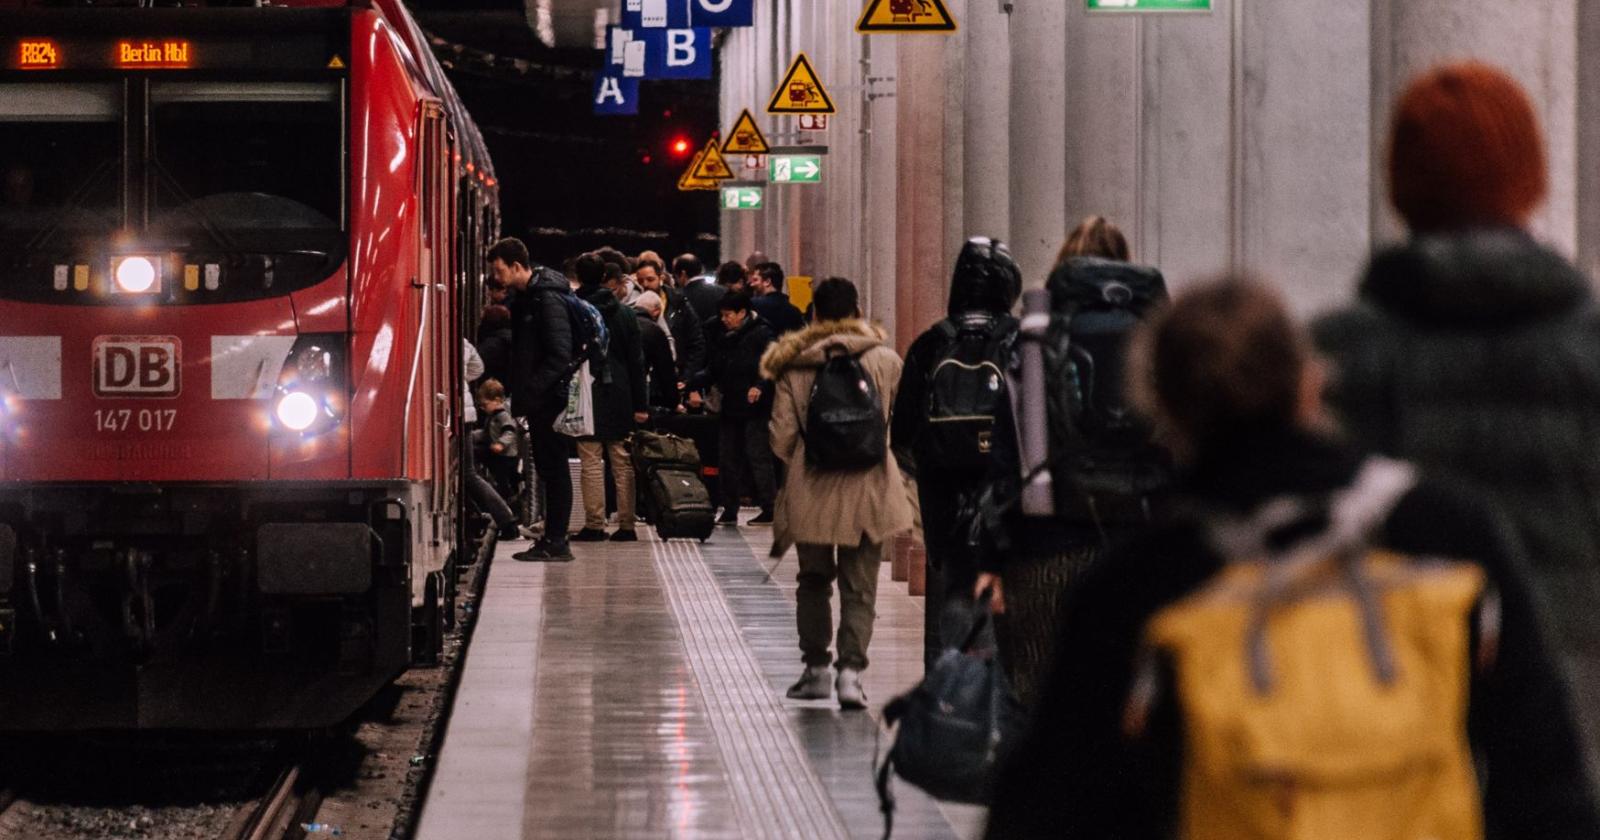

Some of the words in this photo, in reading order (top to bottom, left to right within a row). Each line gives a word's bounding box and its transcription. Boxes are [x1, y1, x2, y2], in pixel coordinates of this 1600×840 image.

[21, 43, 56, 63] RB24
[120, 43, 161, 62] Berlin
[666, 28, 696, 67] B
[596, 77, 625, 105] A
[105, 346, 170, 388] DB
[94, 409, 132, 431] 147
[139, 409, 177, 431] 017
